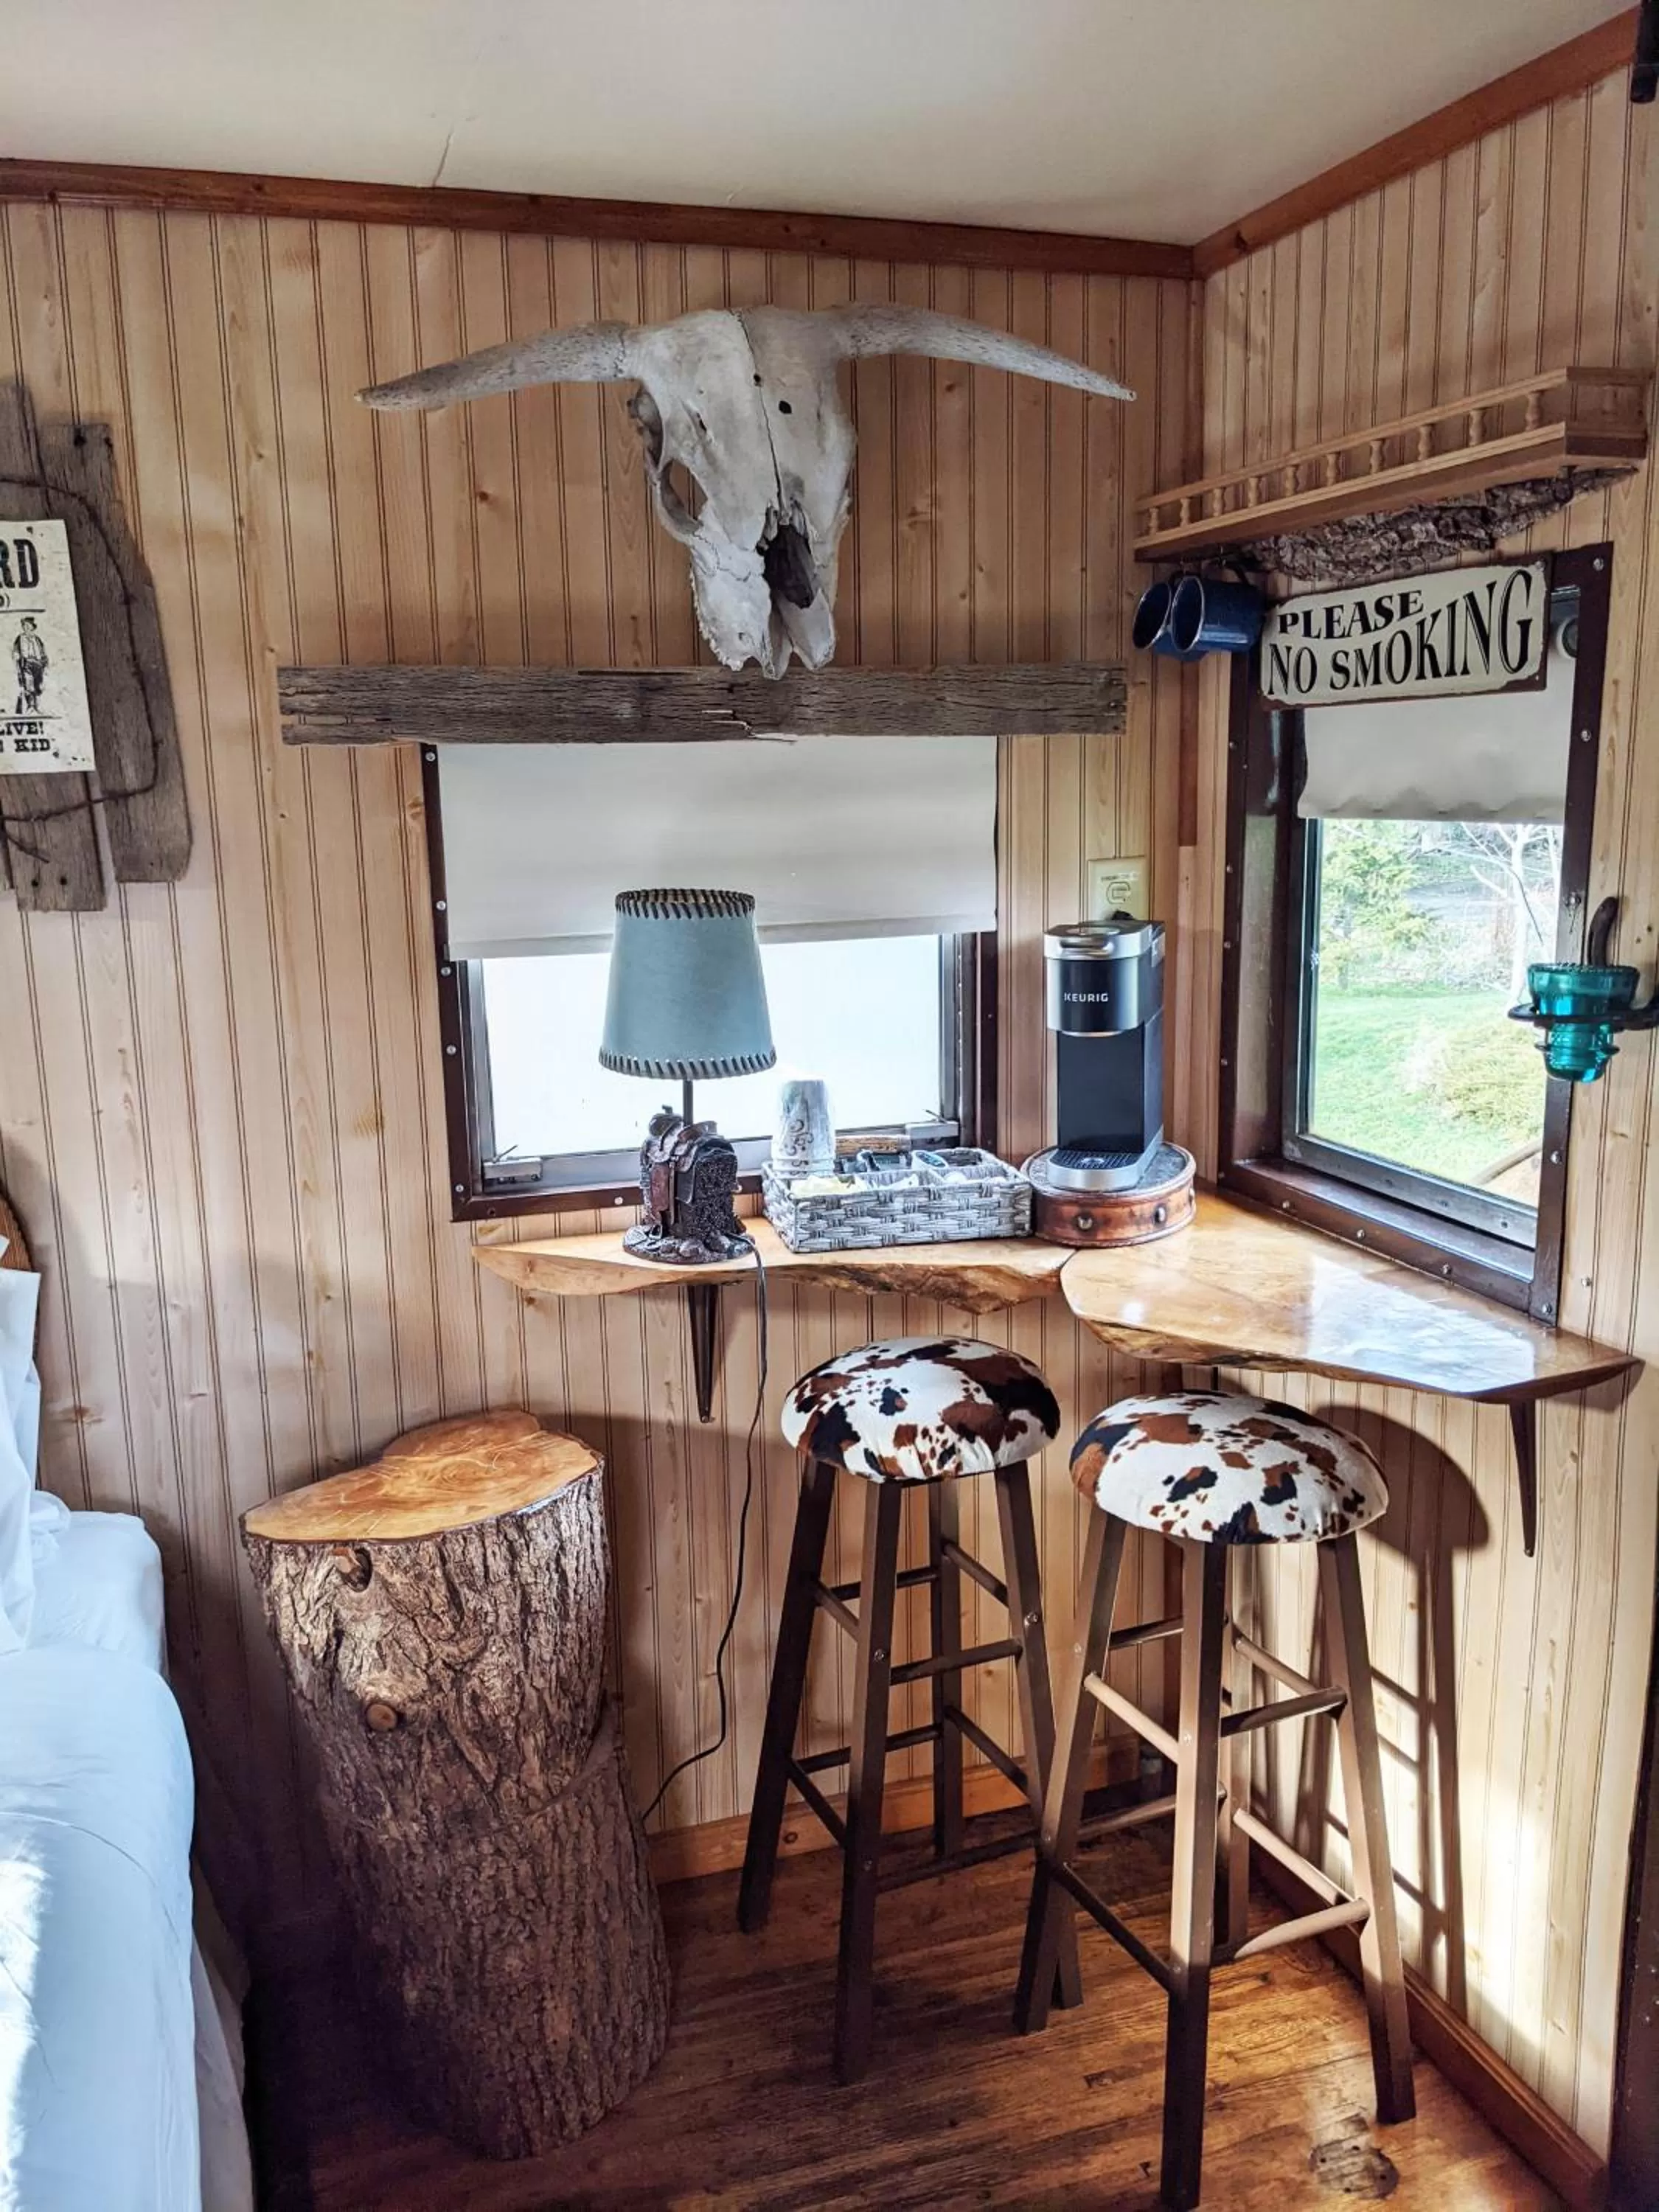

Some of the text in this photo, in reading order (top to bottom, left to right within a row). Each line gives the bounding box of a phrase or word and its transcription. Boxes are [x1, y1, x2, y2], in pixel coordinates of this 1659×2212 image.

[1278, 590, 1424, 640] PLEASE
[1267, 568, 1533, 695] NO SMOKING
[14, 738, 51, 752] KID
[1064, 992, 1108, 1002] KEURIG
